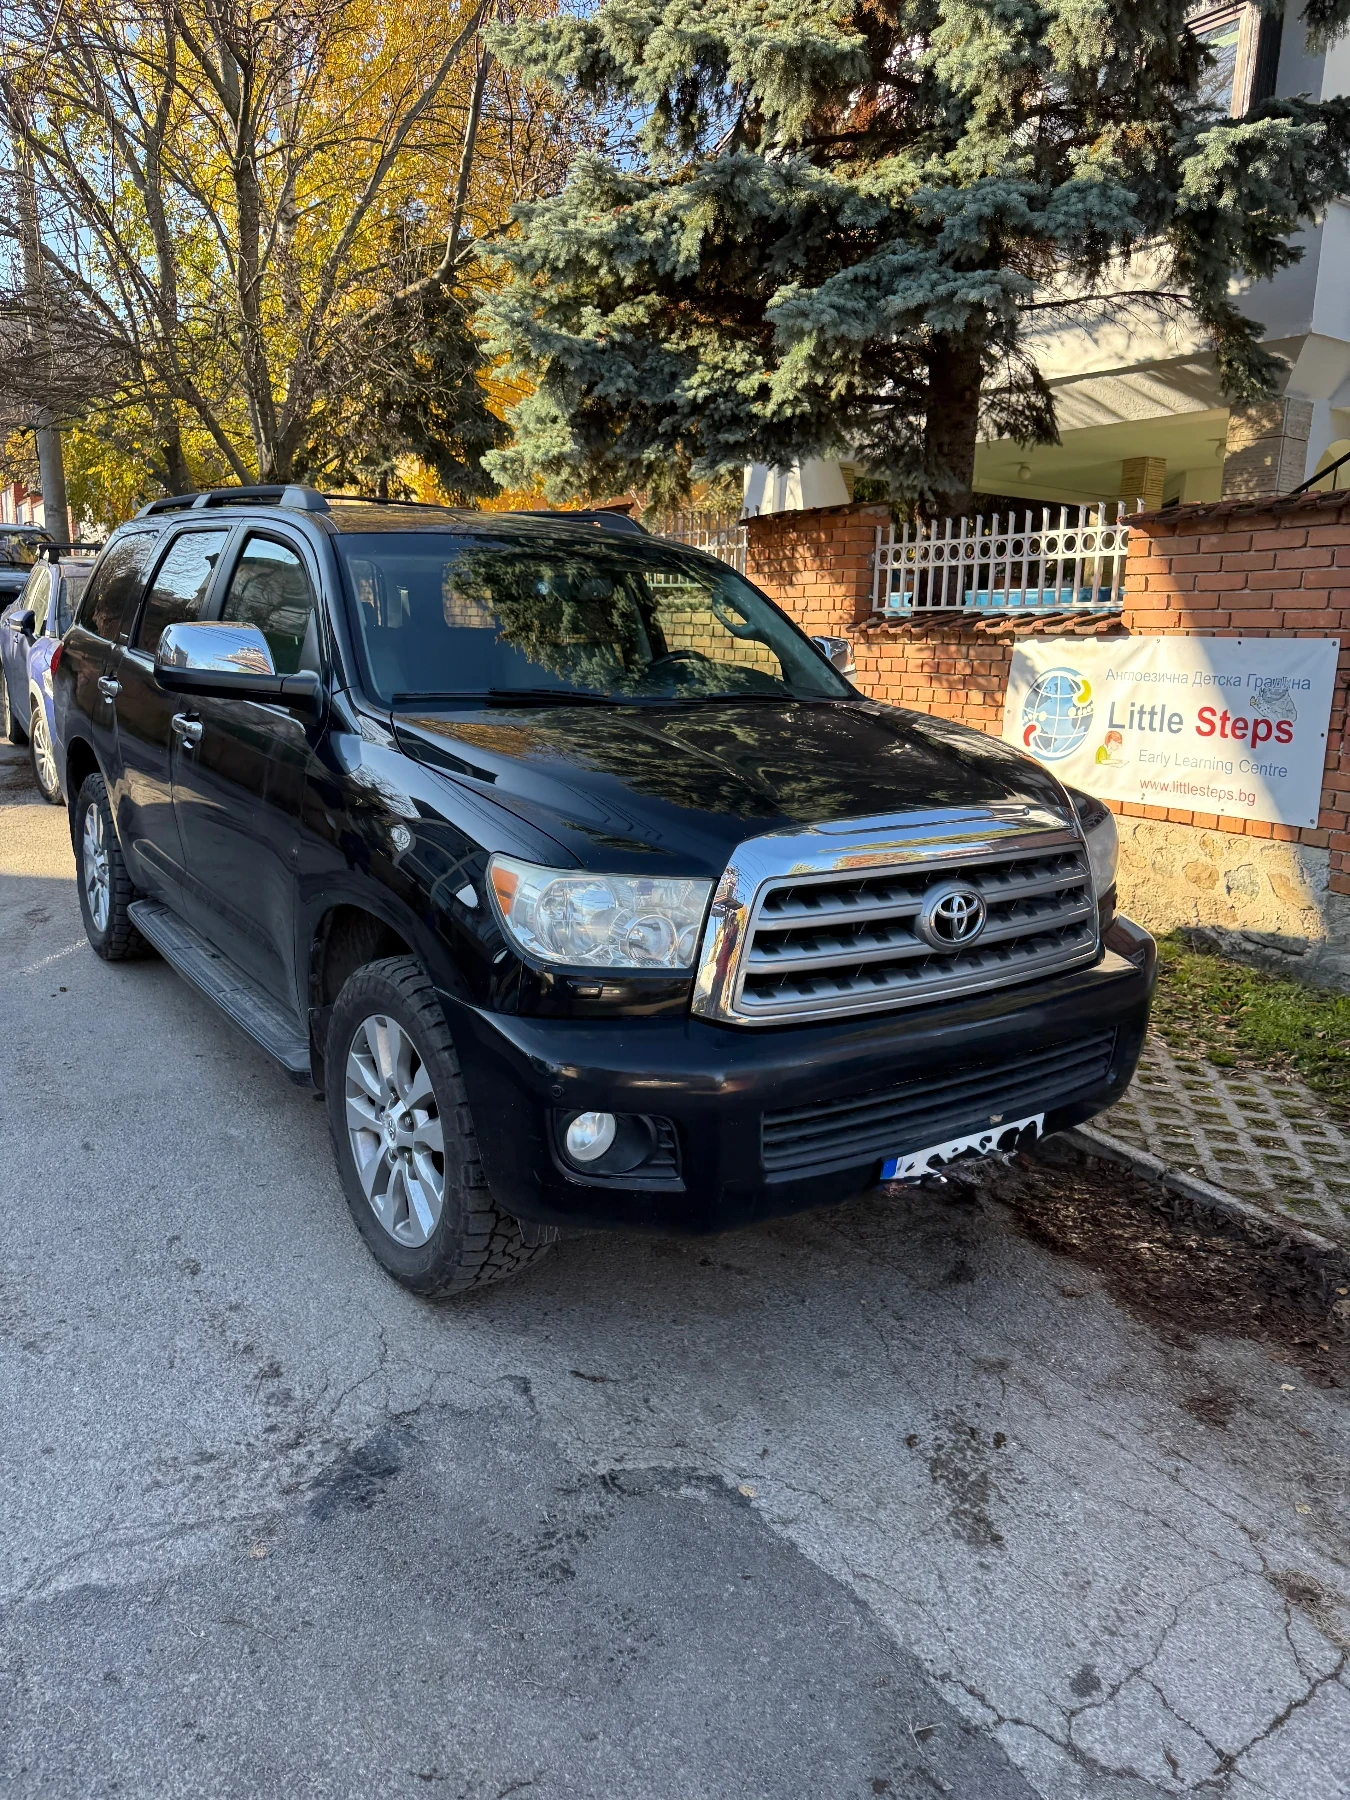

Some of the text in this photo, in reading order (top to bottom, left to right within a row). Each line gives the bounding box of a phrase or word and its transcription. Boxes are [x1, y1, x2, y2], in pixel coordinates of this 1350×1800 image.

[1105, 668, 1188, 684] Англоезична
[1192, 671, 1241, 687] Детска
[1108, 701, 1294, 748] Little Steps
[1138, 749, 1288, 778] Early Learning Centre
[1139, 778, 1256, 806] www.littlesteps.bg
